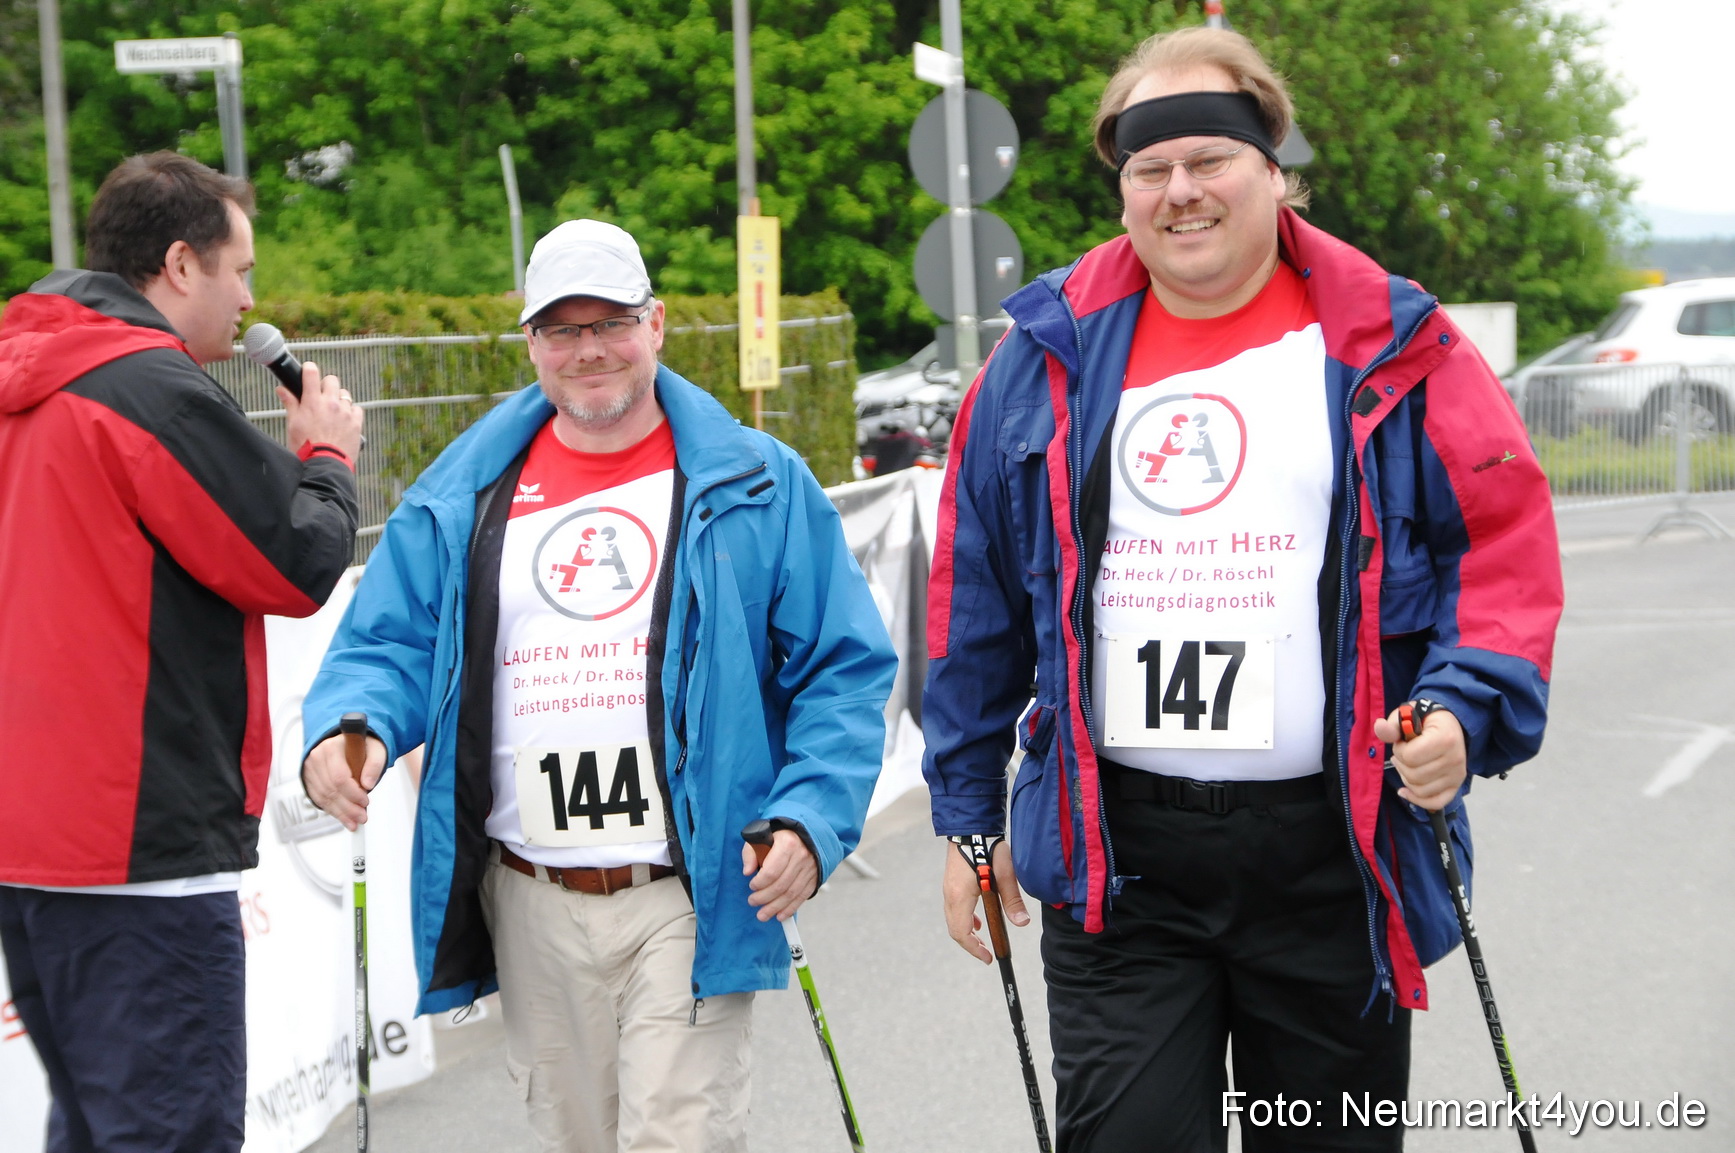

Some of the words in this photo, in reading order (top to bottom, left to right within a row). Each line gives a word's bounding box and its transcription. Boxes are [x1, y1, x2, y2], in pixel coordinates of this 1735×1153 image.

[1176, 539, 1218, 555] MIT
[1231, 532, 1296, 554] HERZ
[1102, 568, 1120, 581] Dr.
[1125, 568, 1164, 581] Heck
[1183, 569, 1206, 582] Dr.
[1213, 565, 1274, 581] Röschl
[1101, 591, 1276, 613] Leistungsdiagnostik
[503, 646, 569, 666] LAUFEN
[581, 642, 620, 658] MIT
[513, 677, 529, 689] Dr.
[533, 672, 568, 686] Heck
[586, 670, 608, 683] Dr.
[615, 668, 647, 681] Rös
[1137, 639, 1246, 731] 147
[514, 693, 646, 717] Leistungsdiagnos
[539, 746, 650, 831] 144
[278, 794, 328, 828] NIS
